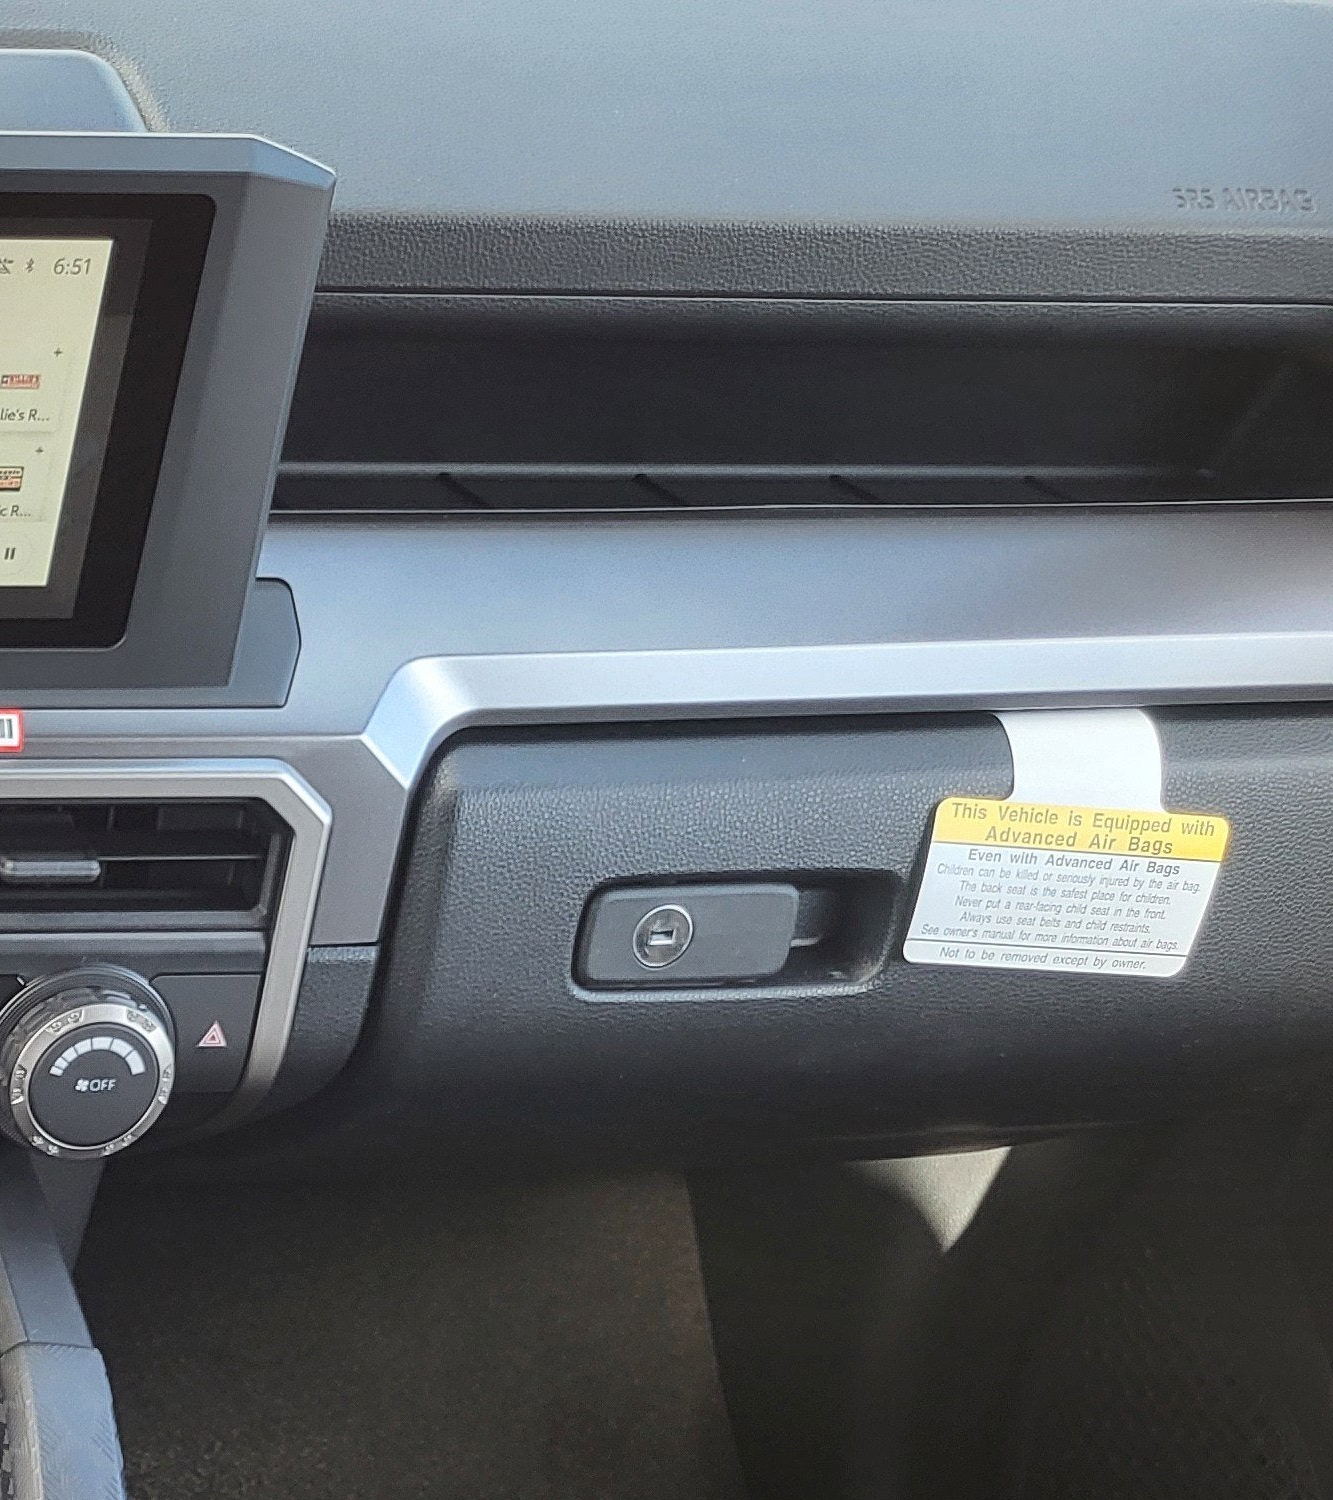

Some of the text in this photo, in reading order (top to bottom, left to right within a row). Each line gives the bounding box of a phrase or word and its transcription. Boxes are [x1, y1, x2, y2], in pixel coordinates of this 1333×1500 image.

[53, 257, 93, 276] 6:51
[951, 802, 1215, 837] This Vehicle is Equipped with
[985, 825, 1173, 856] Advanced Air Bags
[968, 848, 1180, 877] Even with Advanced Air Bags
[937, 862, 1201, 895] Children can be killed or seriously injured by the air bag.
[960, 880, 1171, 905] The back seat the safest place for children.
[954, 895, 983, 908] Never
[985, 898, 1001, 911] put
[1015, 900, 1063, 915] rear-facing
[1066, 903, 1087, 915] child
[1090, 905, 1110, 917] seat
[1113, 906, 1122, 917] in
[1126, 907, 1140, 918] the
[959, 911, 1151, 934] Always use seat belts and child restraints.
[921, 923, 1179, 952] See owner's manual for more information about air bags.
[939, 946, 1146, 970] Not to be removed except by owner.
[89, 1078, 117, 1093] OFF
